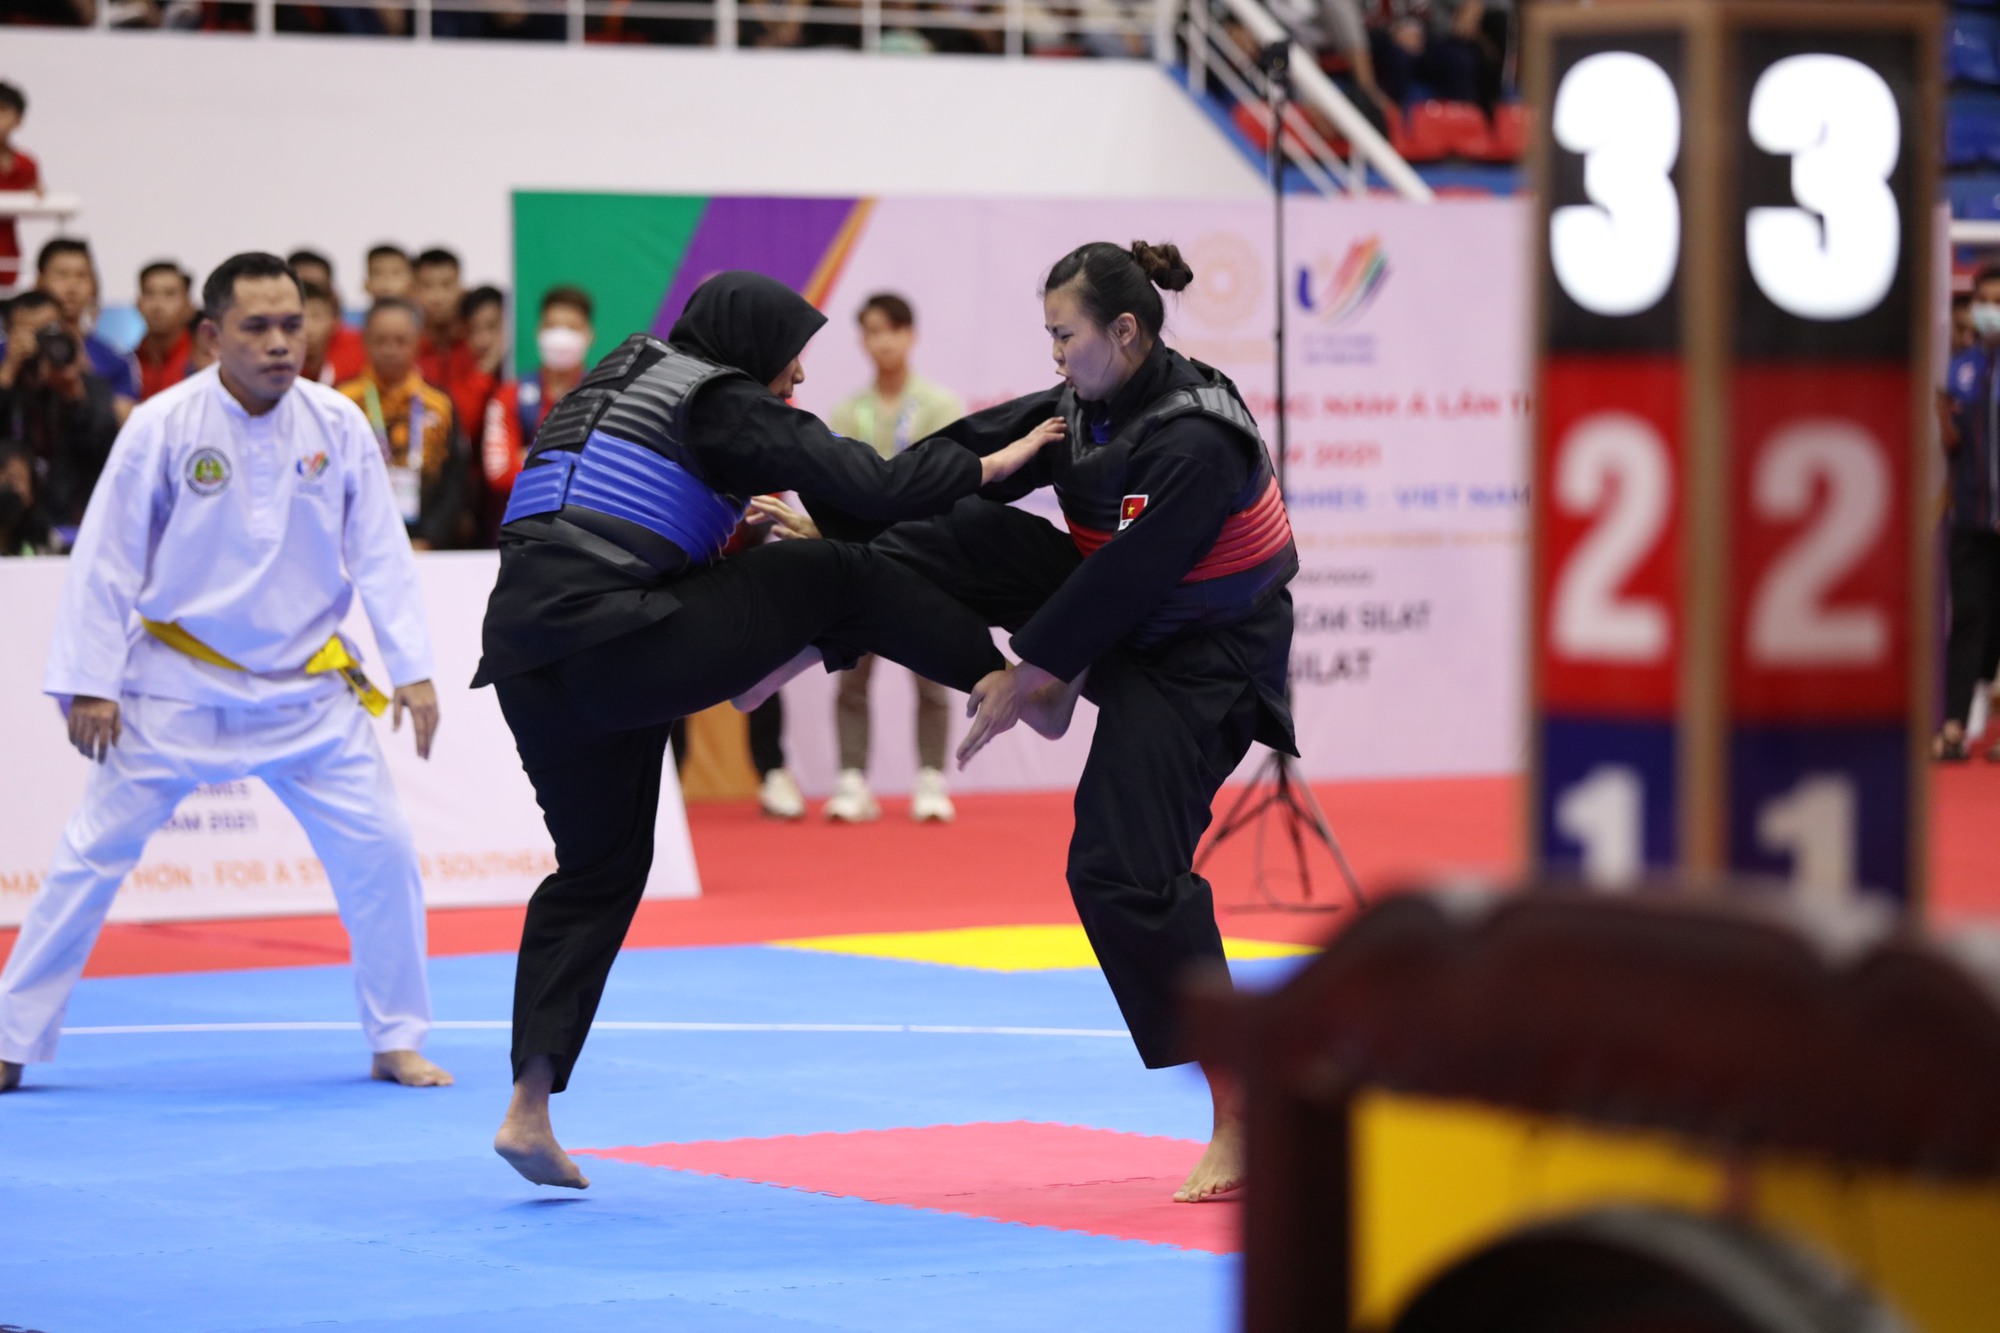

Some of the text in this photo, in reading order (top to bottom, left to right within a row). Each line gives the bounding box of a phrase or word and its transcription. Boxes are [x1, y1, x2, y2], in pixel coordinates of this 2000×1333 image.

[1551, 51, 1680, 316] 3
[1746, 53, 1900, 321] 3
[1322, 393, 1399, 418] NAM
[1360, 601, 1431, 634] SILAT
[1552, 413, 1673, 662] 2
[1750, 422, 1896, 668] 2
[214, 860, 267, 889] FOR
[1556, 765, 1645, 893] 1
[1758, 775, 1904, 948] 1
